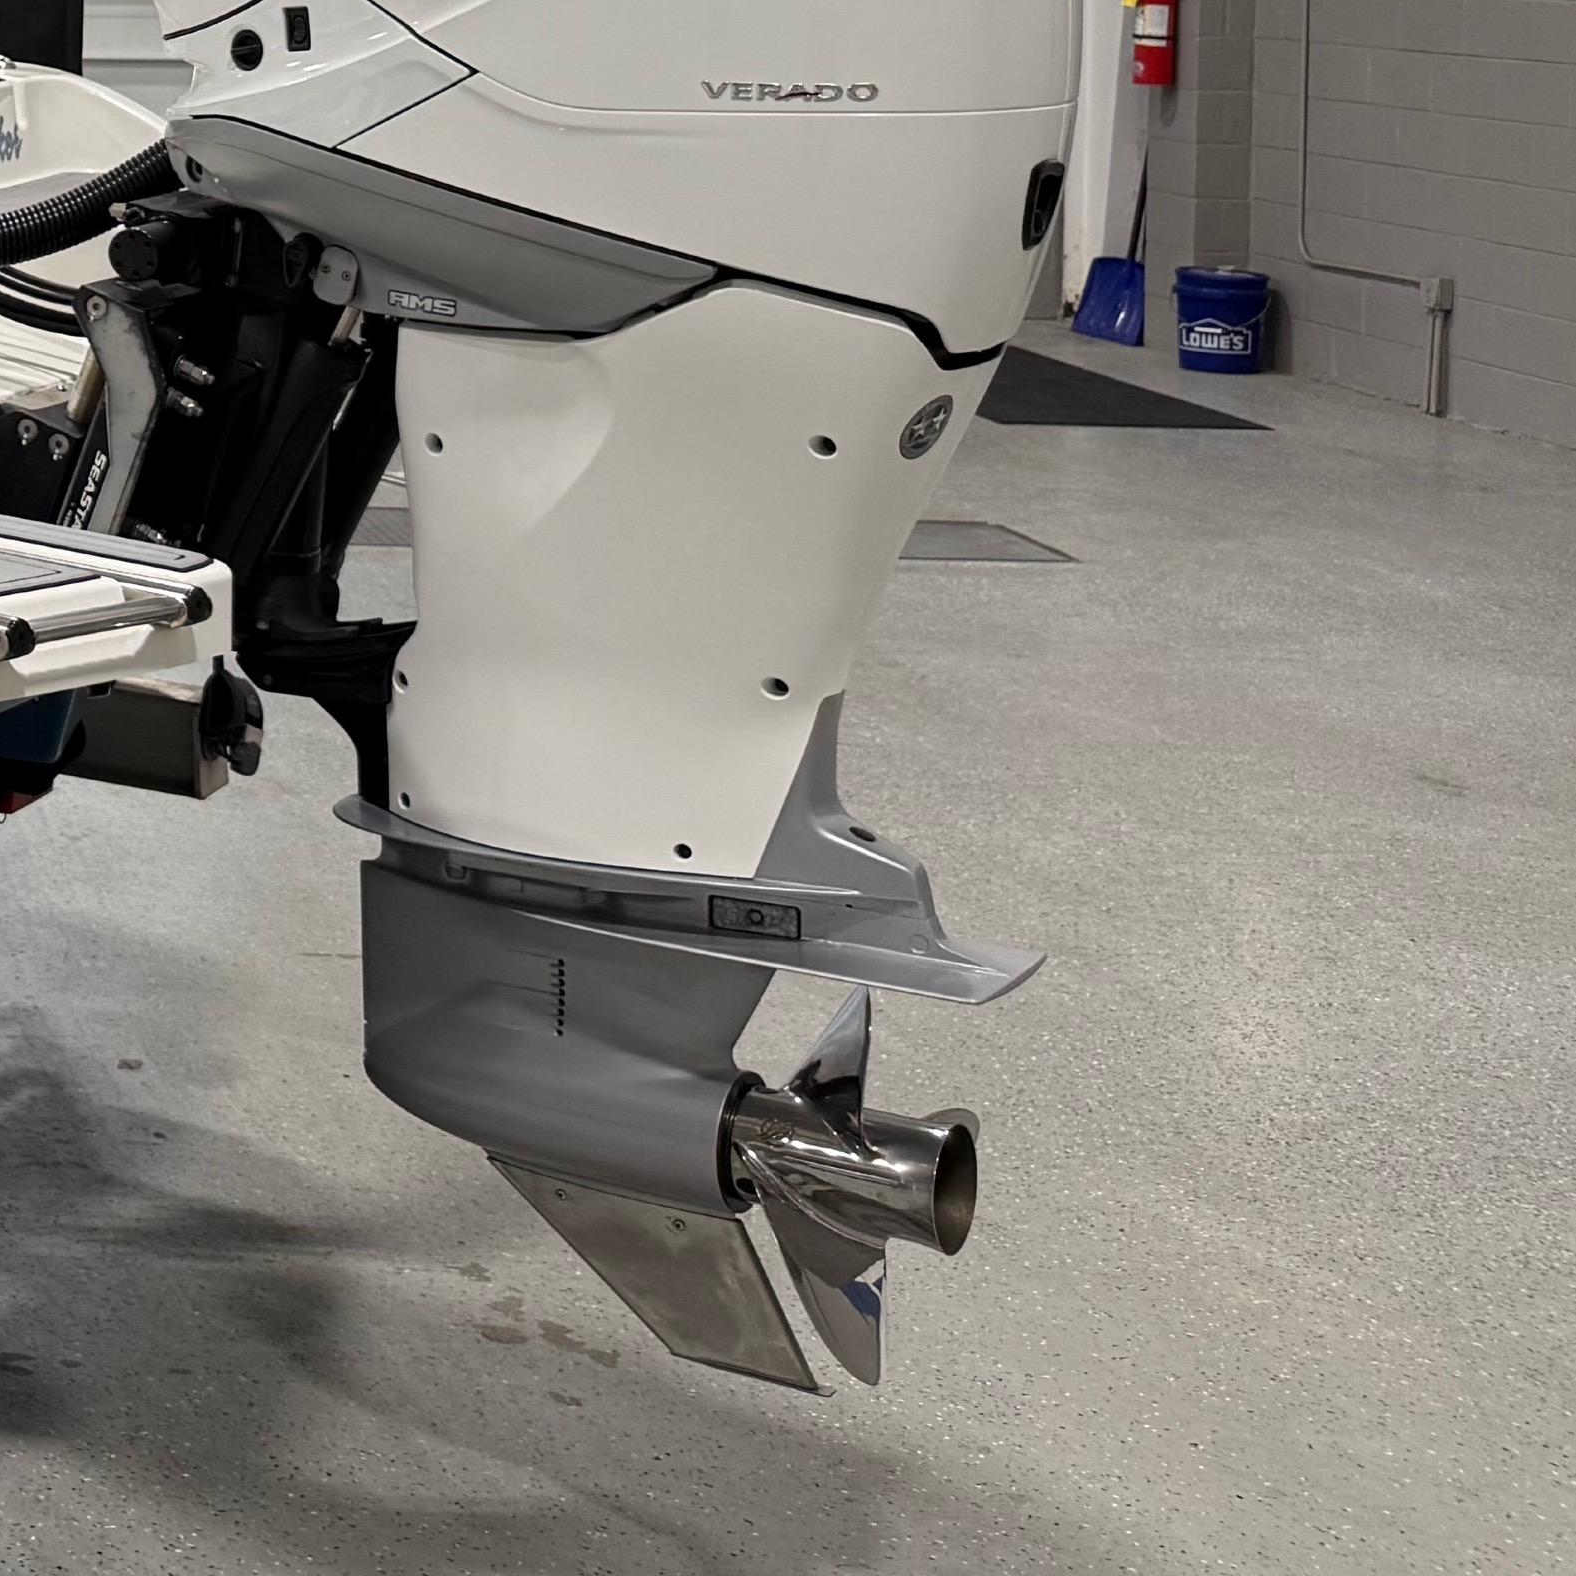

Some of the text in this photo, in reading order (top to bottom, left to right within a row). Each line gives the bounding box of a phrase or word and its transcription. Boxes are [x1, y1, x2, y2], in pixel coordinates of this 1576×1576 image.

[700, 80, 879, 103] VERADO
[388, 290, 457, 316] AMS
[1182, 328, 1246, 351] LOWE'S
